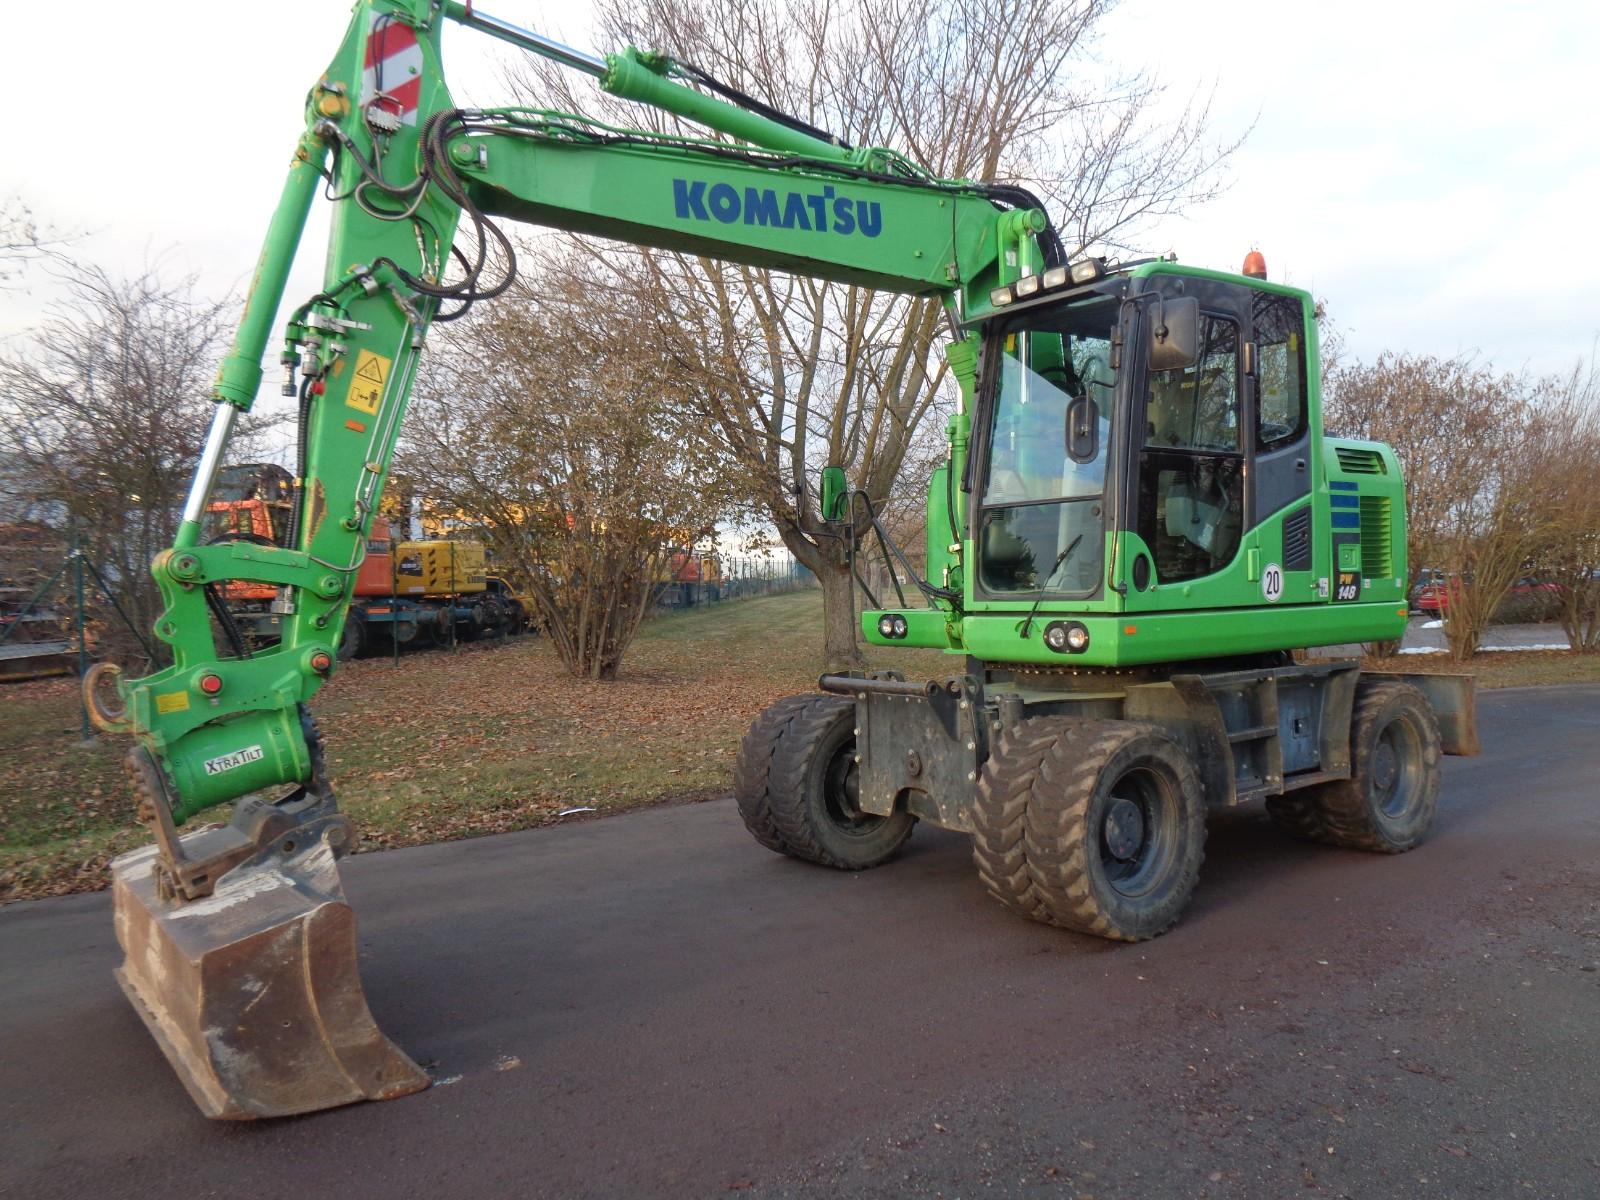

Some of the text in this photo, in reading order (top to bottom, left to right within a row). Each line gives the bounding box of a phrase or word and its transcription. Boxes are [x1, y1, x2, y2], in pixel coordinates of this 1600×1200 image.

[672, 179, 882, 238] KOMATSU
[1266, 570, 1280, 595] 20
[1339, 573, 1354, 585] PW
[1338, 585, 1357, 600] 148
